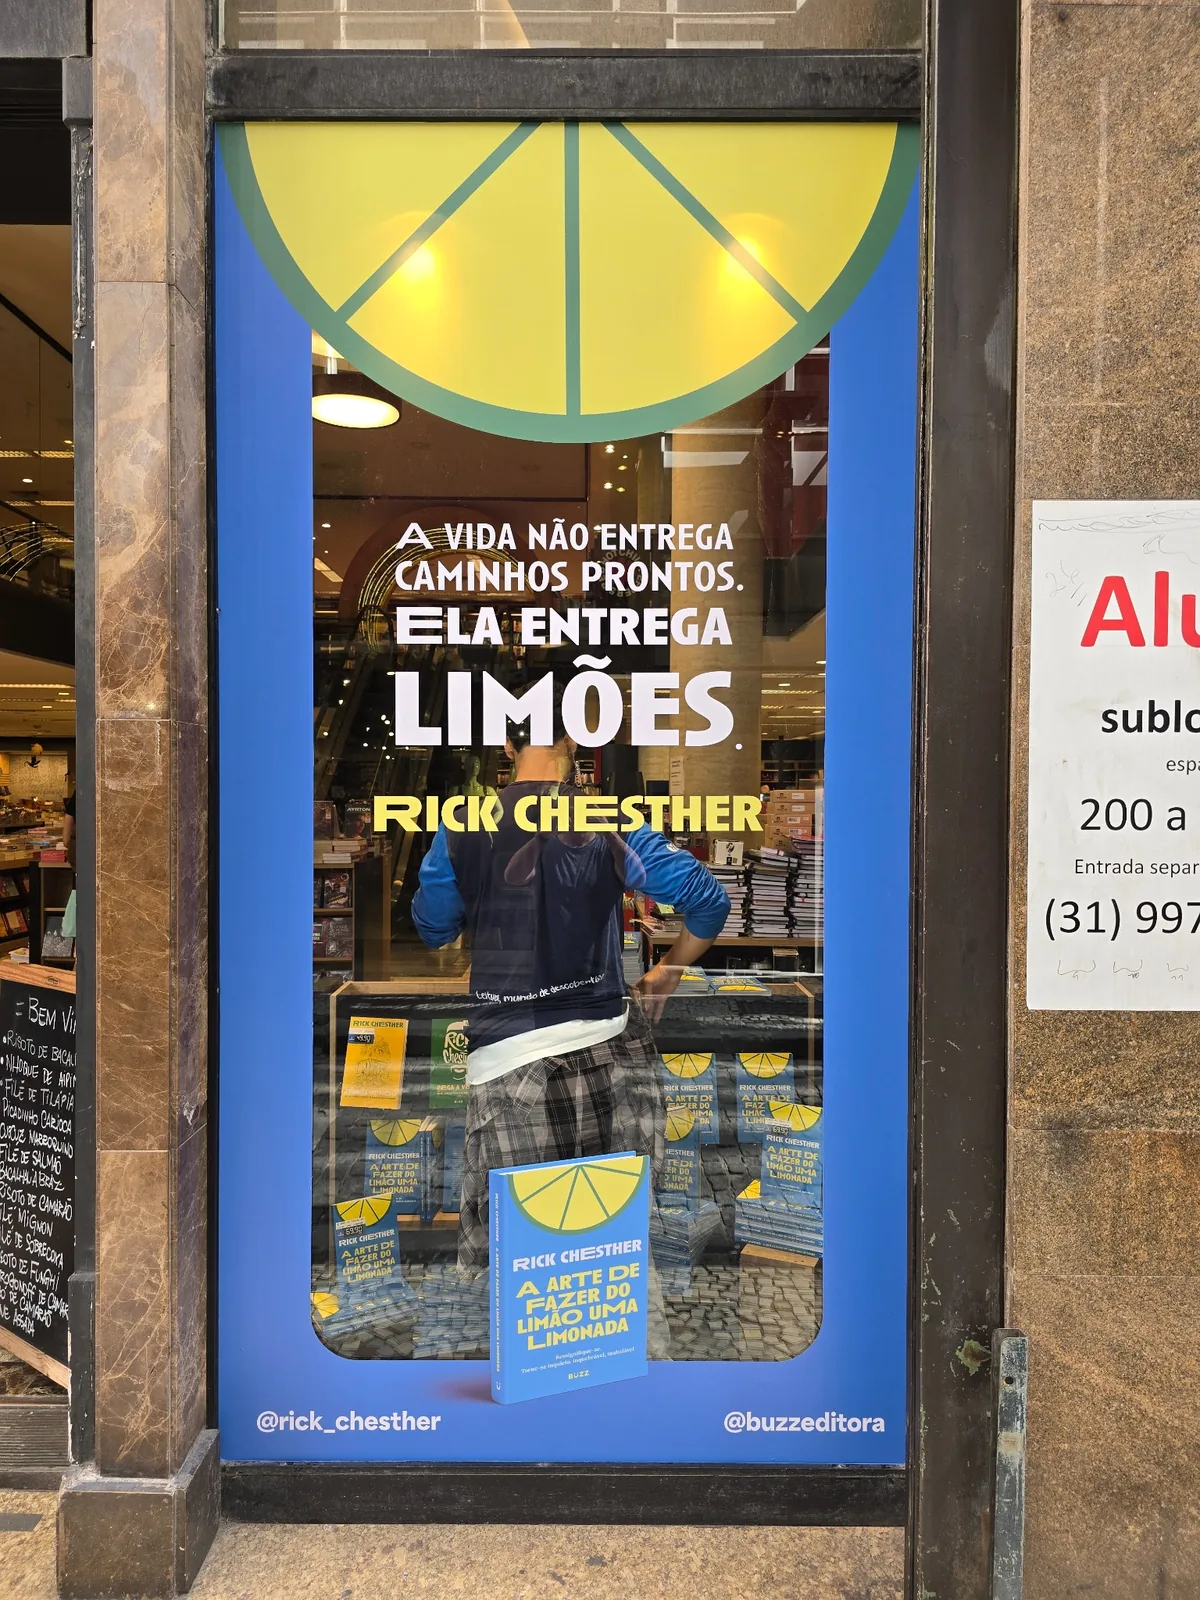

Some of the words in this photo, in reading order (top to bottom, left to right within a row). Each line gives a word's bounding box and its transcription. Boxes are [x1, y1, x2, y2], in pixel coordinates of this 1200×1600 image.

[395, 522, 431, 549] A
[444, 523, 517, 550] VIDA
[528, 518, 589, 551] NÃO
[600, 523, 734, 551] ENTREGA
[394, 561, 568, 592] CAMINHOS
[582, 561, 745, 592] PRONTOS.
[396, 606, 503, 645] ELA
[521, 607, 732, 646] ENTREGA
[394, 654, 743, 750] LIMÕES.
[373, 795, 500, 832] RICK
[513, 795, 764, 832] CHESTHER
[1080, 798, 1153, 832] 200
[1166, 806, 1186, 832] a
[1075, 859, 1145, 875] Entrada
[1045, 898, 1121, 941] (31)
[503, 992, 537, 1003] mundo
[539, 988, 550, 998] de
[28, 995, 57, 1030] BEM
[7, 1030, 36, 1055] RISOTO
[38, 1045, 48, 1059] DE
[42, 1067, 53, 1086] DE
[5, 1078, 25, 1101] FILÉ
[28, 1087, 38, 1103] DE
[40, 1109, 72, 1136] CARIOCA
[766, 1134, 784, 1143] RICK
[785, 1137, 820, 1149] CHESTHER
[21, 1150, 31, 1165] DE
[387, 1152, 420, 1160] CHESTHER
[767, 1145, 776, 1153] A
[779, 1147, 802, 1158] ARTE
[804, 1151, 819, 1161] DE
[770, 1154, 800, 1165] FAZER
[803, 1160, 814, 1168] DO
[372, 1170, 403, 1178] FAZER
[404, 1170, 415, 1178] DO
[381, 1162, 404, 1170] ARTE
[405, 1162, 420, 1170] DE
[795, 1166, 817, 1177] UMA
[397, 1178, 418, 1186] UMA
[672, 1174, 694, 1184] UMA
[770, 1170, 813, 1184] LIMONADA
[372, 1186, 414, 1194] LIMONADA
[27, 1193, 37, 1208] DE
[18, 1208, 53, 1237] MIGNON
[338, 1237, 358, 1247] RICK
[359, 1229, 395, 1242] CHESTHER
[15, 1231, 23, 1249] DE
[26, 1233, 64, 1270] SOBRECOXA
[341, 1250, 352, 1260] A
[354, 1244, 378, 1256] ARTE
[381, 1240, 395, 1250] DE
[345, 1252, 378, 1266] FAZER
[380, 1250, 391, 1259] DO
[512, 1251, 556, 1272] RICK
[560, 1239, 642, 1264] CHESTHER
[374, 1257, 396, 1269] UMA
[19, 1258, 29, 1274] DE
[30, 1260, 60, 1292] FUNGHI
[347, 1266, 393, 1284] LIMONADA
[515, 1280, 540, 1299] A
[546, 1268, 602, 1294] ARTE
[608, 1262, 640, 1282] DE
[9, 1291, 19, 1305] DE
[39, 1289, 47, 1305] DE
[526, 1288, 600, 1315] FAZER
[606, 1282, 631, 1300] DO
[13, 1308, 35, 1338] ASSADA
[517, 1307, 582, 1335] LIMÃO
[589, 1298, 639, 1321] UMA
[527, 1317, 629, 1351] LIMONADA
[256, 1410, 442, 1434] @rick_chesther
[724, 1410, 886, 1433] @buzzeditora
